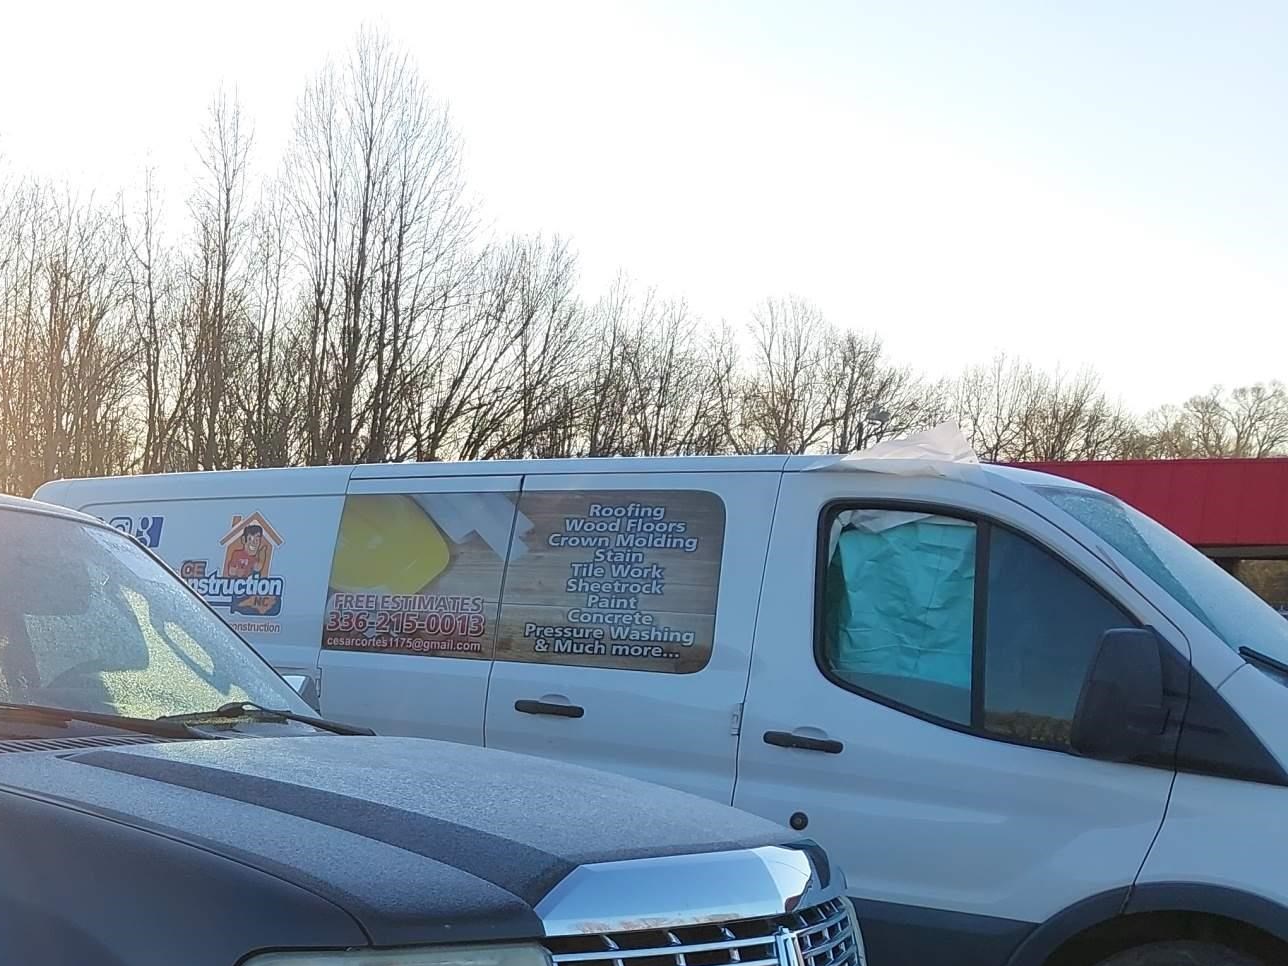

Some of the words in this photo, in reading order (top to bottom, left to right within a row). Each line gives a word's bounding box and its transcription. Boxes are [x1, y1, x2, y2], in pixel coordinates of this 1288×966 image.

[589, 504, 665, 520] Roofing
[566, 519, 620, 532] Wood
[626, 519, 686, 532] Floors
[548, 534, 609, 547] Crown
[615, 535, 698, 551] Molding
[594, 549, 644, 562] Stain
[571, 564, 605, 577] Tile
[611, 565, 663, 579] Work
[186, 572, 282, 596] nstruction
[567, 579, 663, 594] Sheetrock
[334, 593, 376, 609] FREE
[380, 596, 483, 613] ESTIMATES
[587, 595, 637, 609] Paint
[326, 610, 485, 637] 336-215-0013
[567, 610, 653, 625] Concrete
[231, 622, 280, 633] onstruction
[524, 625, 604, 640] Pressure
[610, 627, 696, 646] Washing
[327, 637, 481, 652] cesarcortes1175@gmail.com
[534, 639, 549, 653] &
[554, 640, 606, 655] Much
[611, 644, 680, 659] more...
